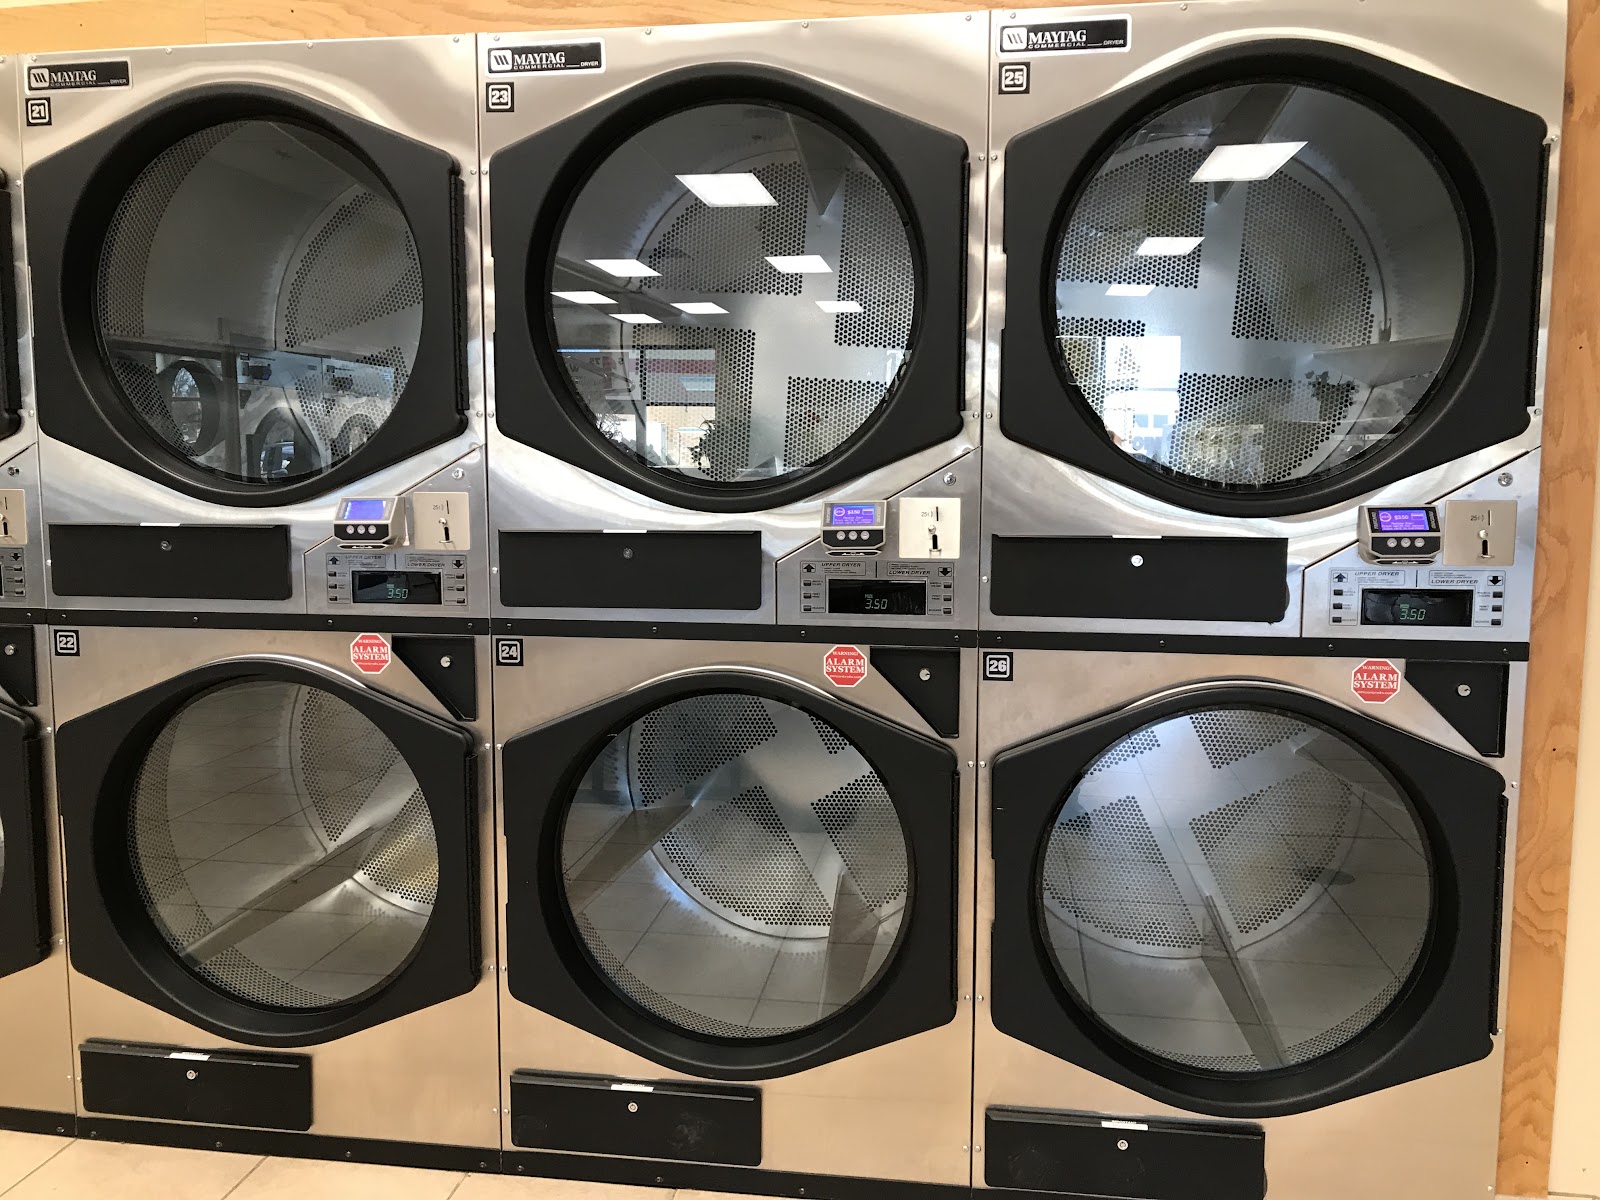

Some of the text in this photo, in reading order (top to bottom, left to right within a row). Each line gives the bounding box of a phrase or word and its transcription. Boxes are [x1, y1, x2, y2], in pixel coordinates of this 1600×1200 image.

[1028, 29, 1087, 44] MAYTAG
[513, 52, 566, 66] MAYTAG
[50, 69, 97, 82] MAYTAG
[1004, 71, 1024, 85] 25
[491, 90, 508, 103] 23
[32, 105, 45, 118] 21
[387, 588, 409, 599] 3.50
[864, 598, 888, 610] 3.50
[1399, 608, 1426, 621] 3.50
[59, 636, 74, 648] 22
[353, 645, 388, 653] ALARM
[501, 645, 518, 657] 24
[352, 652, 389, 660] SYSTEM
[826, 657, 865, 666] ALARM
[825, 665, 865, 674] SYSTEM
[989, 659, 1007, 672] 26
[1353, 672, 1398, 681] ALARM
[1353, 680, 1398, 689] SYSTEM
